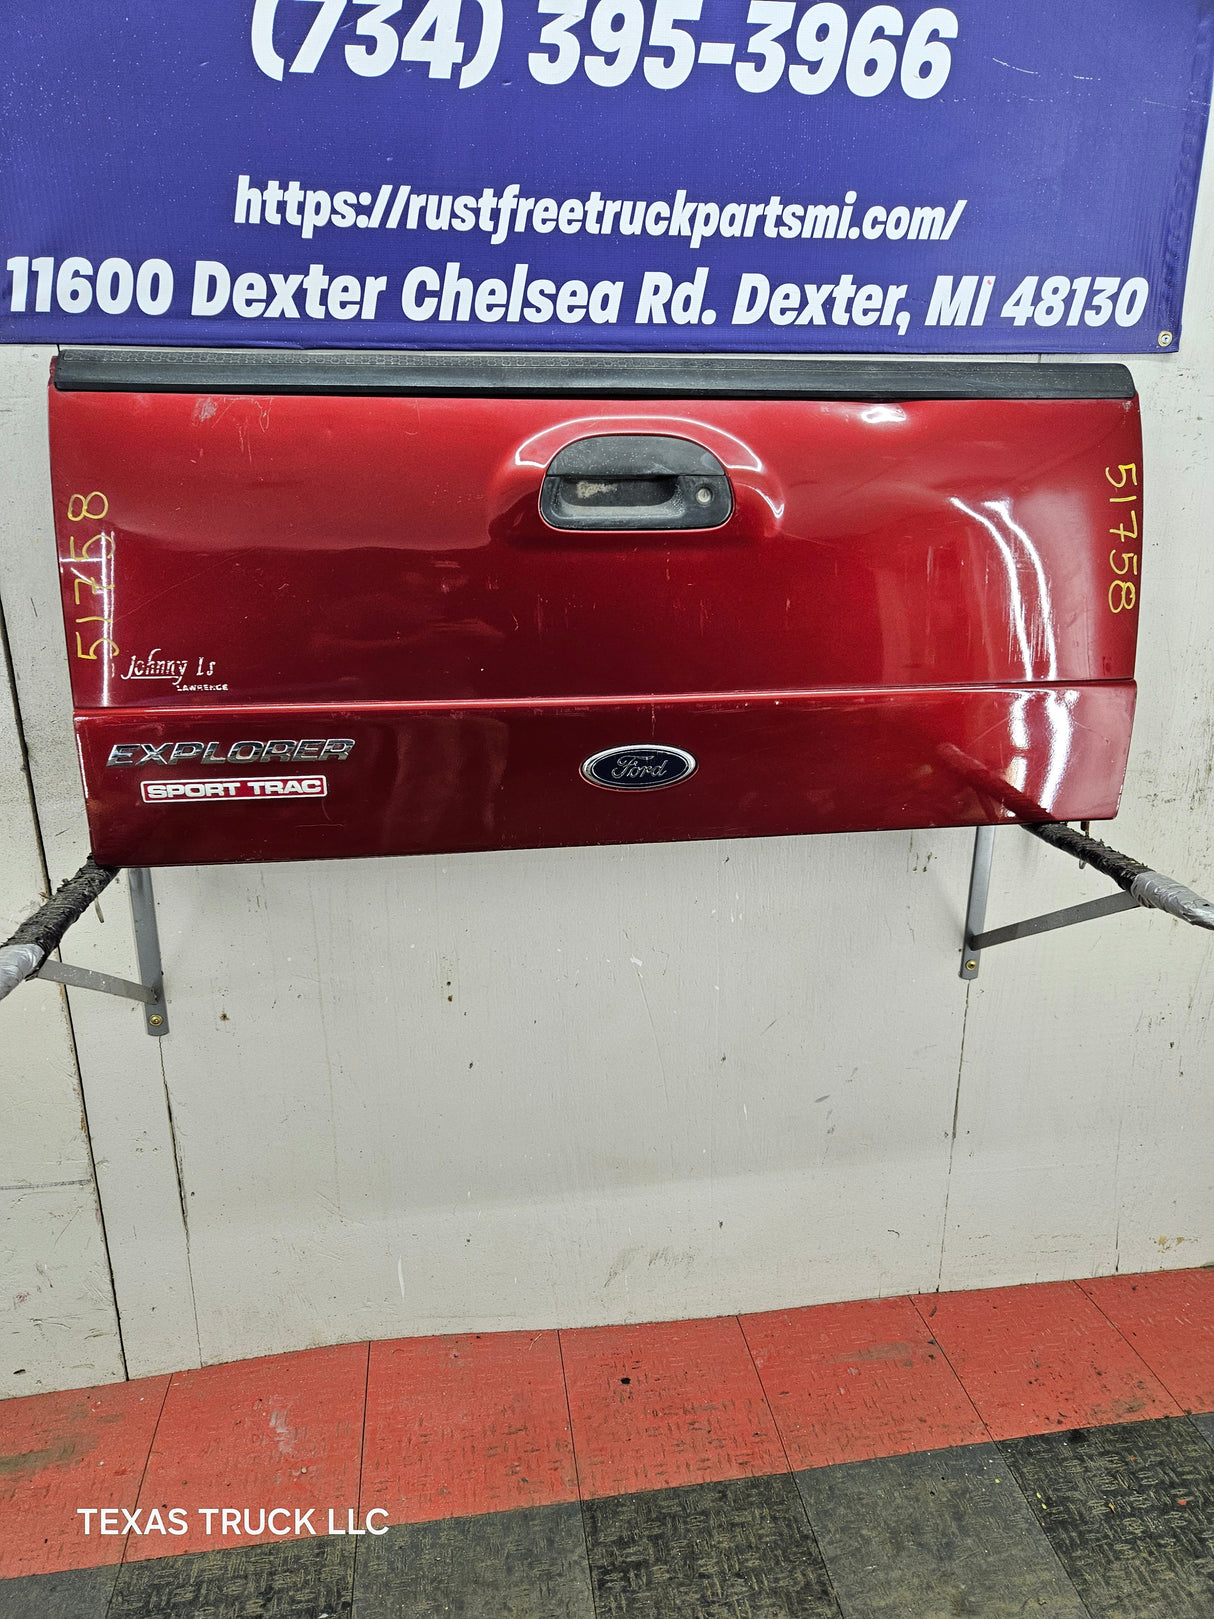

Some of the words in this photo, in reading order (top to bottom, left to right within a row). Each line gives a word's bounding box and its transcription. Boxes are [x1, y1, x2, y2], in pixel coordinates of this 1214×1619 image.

[251, 0, 504, 89] (734)
[528, 0, 959, 100] 395-3966
[234, 174, 968, 249] https://rustfreetruckpartsmi.com/
[6, 256, 174, 316] 11600
[191, 260, 387, 320] Dexter
[401, 262, 624, 324] Chelsea
[634, 267, 717, 325] Rd.
[731, 273, 908, 336] Dexter,
[924, 275, 996, 327] MI
[1000, 276, 1149, 328] 48130
[67, 491, 120, 660] 51758
[1105, 463, 1138, 614] 51758
[121, 648, 188, 686] Johnny
[106, 738, 356, 768] EXPLORER
[147, 782, 241, 799] SPORT
[247, 779, 322, 795] TRAC
[611, 755, 669, 779] Ford
